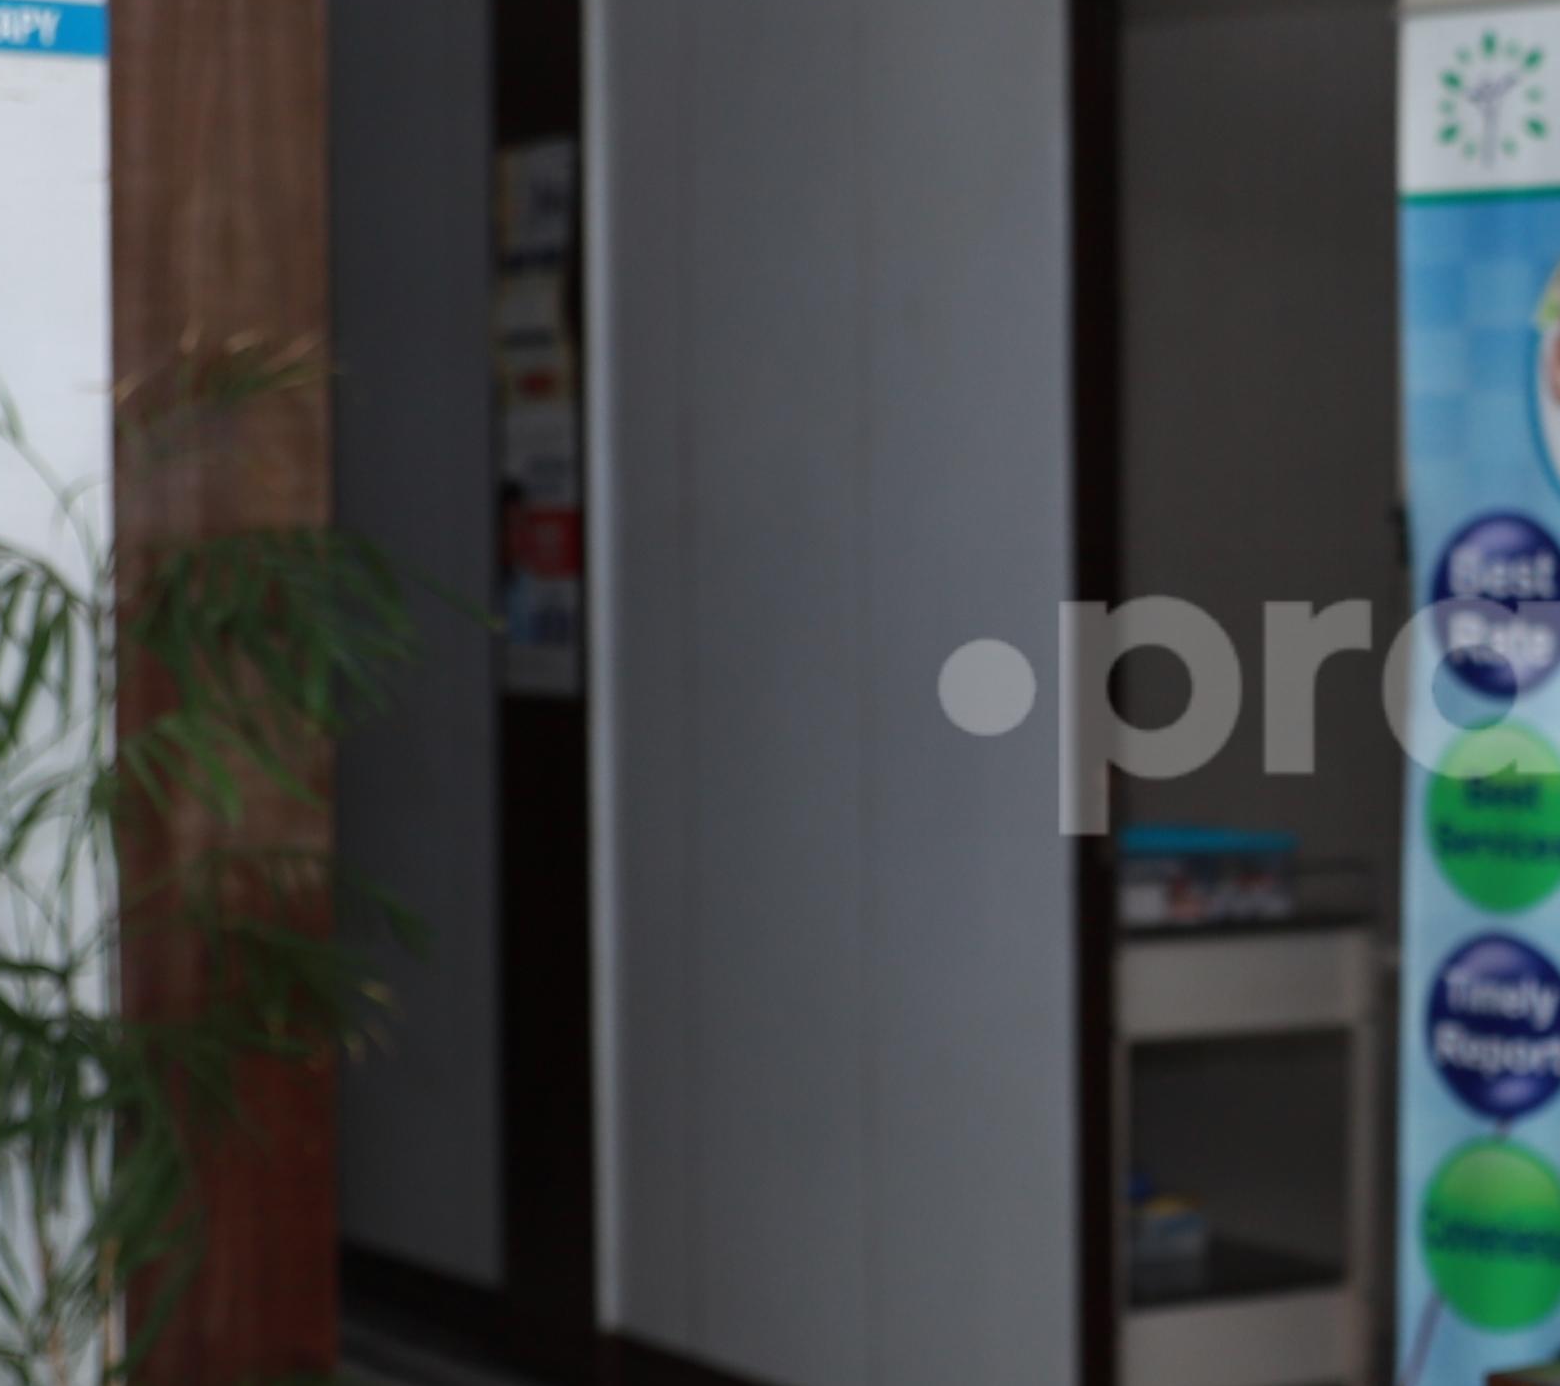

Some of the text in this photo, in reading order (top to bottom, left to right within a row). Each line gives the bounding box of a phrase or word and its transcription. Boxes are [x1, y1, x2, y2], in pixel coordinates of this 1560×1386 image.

[1449, 549, 1554, 600] Best
[1448, 616, 1554, 668] Rate
[1442, 974, 1560, 1027] Timely
